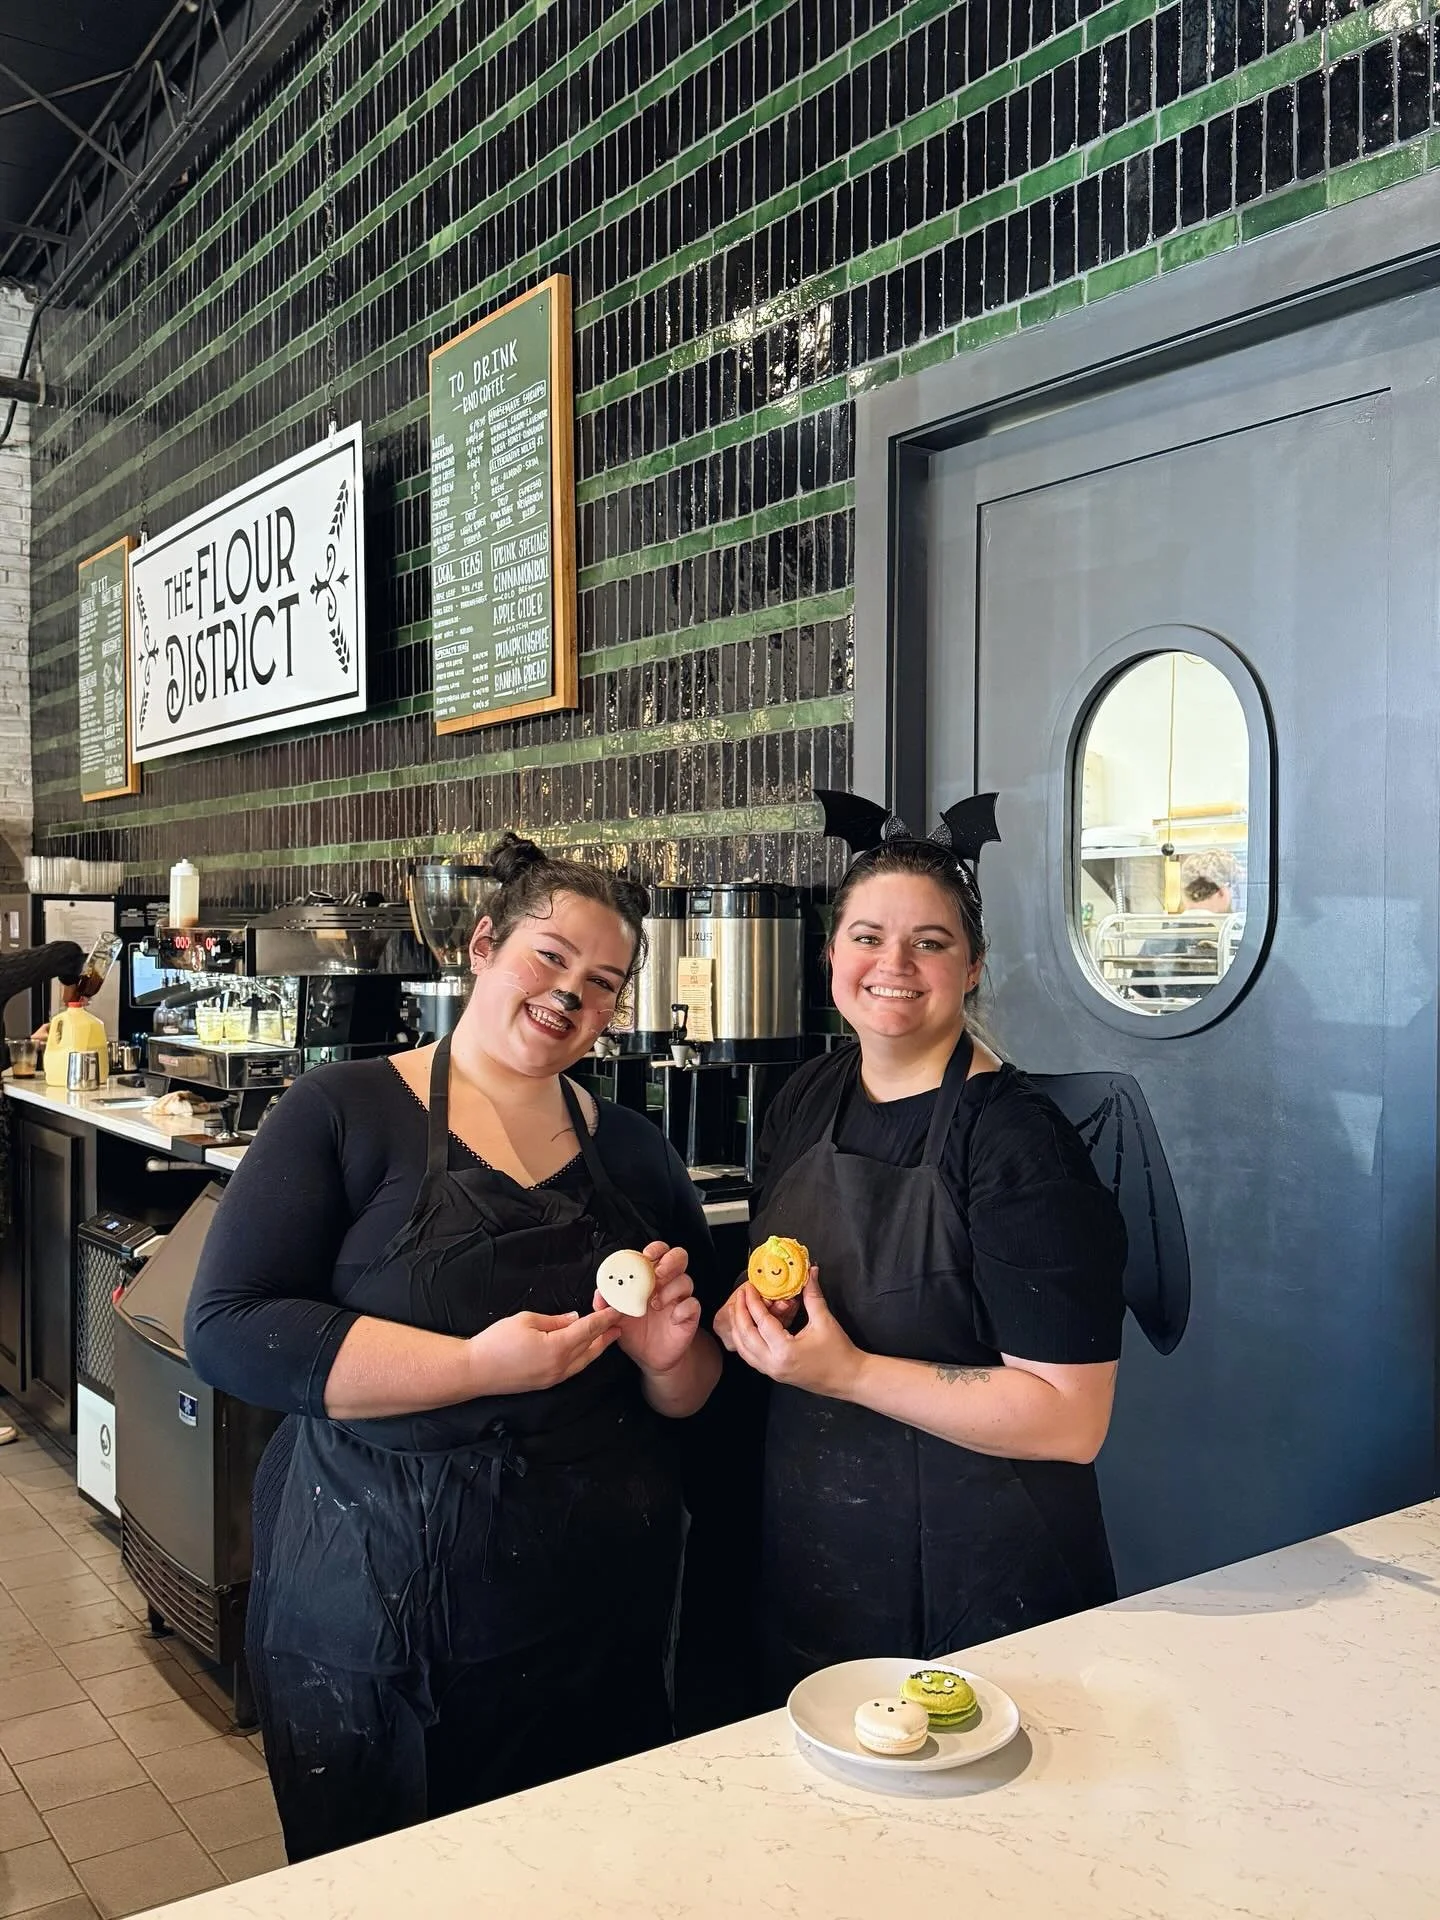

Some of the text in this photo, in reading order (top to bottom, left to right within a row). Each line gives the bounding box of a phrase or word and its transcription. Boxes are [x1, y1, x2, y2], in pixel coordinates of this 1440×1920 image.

[448, 339, 517, 397] TO DRINK
[479, 374, 505, 404] COFFEE
[164, 566, 192, 620] THE
[197, 506, 295, 620] FLOUR
[494, 531, 548, 568] DRINK SPECIALS
[433, 553, 479, 586] LOCAL TEAS
[494, 592, 543, 625] APPLE CIDER
[165, 593, 299, 724] DISTRICT
[494, 666, 523, 692] BANANA
[524, 659, 546, 685] BREAD
